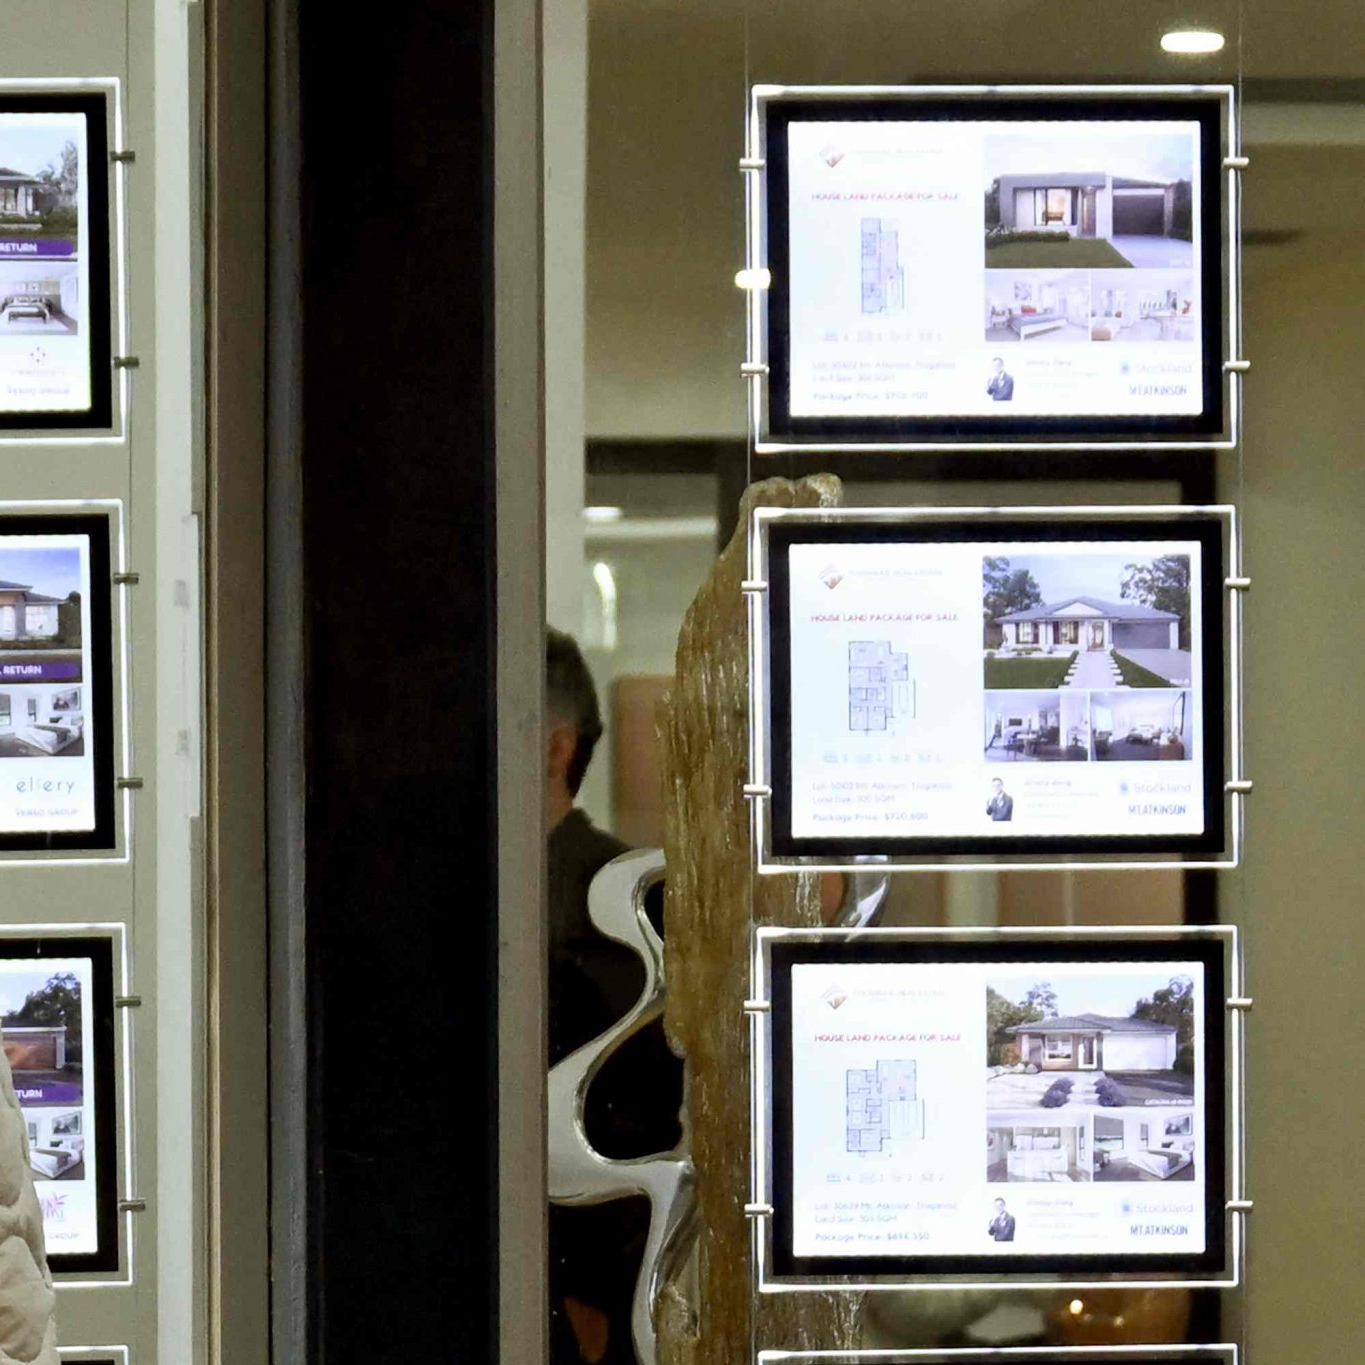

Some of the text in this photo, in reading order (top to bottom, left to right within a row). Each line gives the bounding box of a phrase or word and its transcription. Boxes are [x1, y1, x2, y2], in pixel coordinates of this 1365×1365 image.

[1135, 363, 1193, 374] Stockland
[3, 666, 42, 676] RETURN
[17, 778, 73, 793] ellery
[1134, 783, 1192, 795] Stockland
[874, 1034, 916, 1042] PACKAGE
[920, 1034, 936, 1042] FOR
[941, 1034, 960, 1042] SALE
[14, 1090, 42, 1101] TURN
[1136, 1204, 1194, 1214] Stockland
